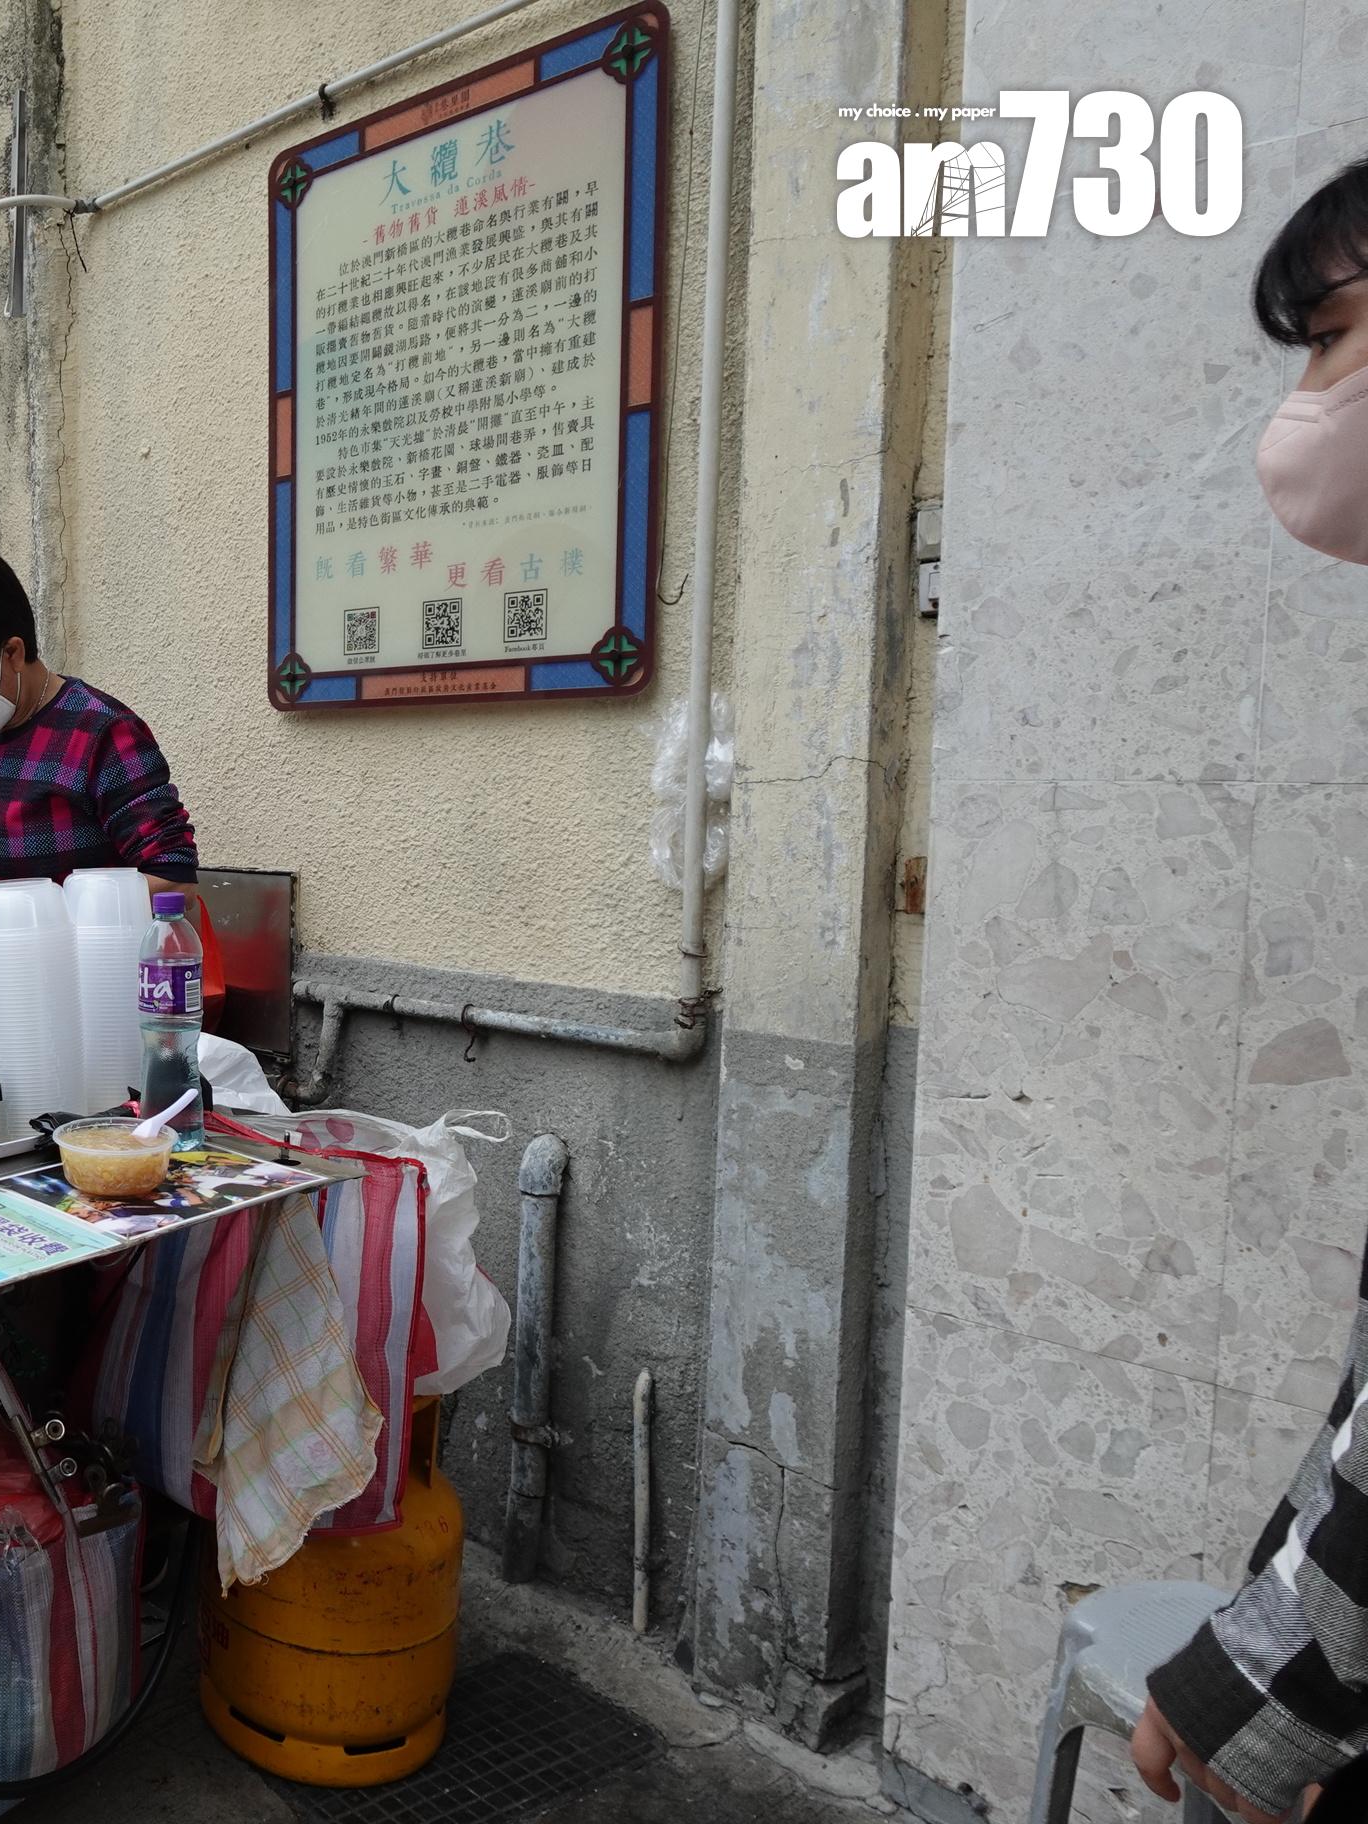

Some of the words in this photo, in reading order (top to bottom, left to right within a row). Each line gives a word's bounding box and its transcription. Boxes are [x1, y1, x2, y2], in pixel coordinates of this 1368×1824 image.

[379, 119, 515, 206] 大纜巷
[447, 183, 460, 195] da
[466, 169, 503, 189] Corda
[315, 540, 433, 581] 既看繁華
[446, 548, 584, 590] 更看古樸
